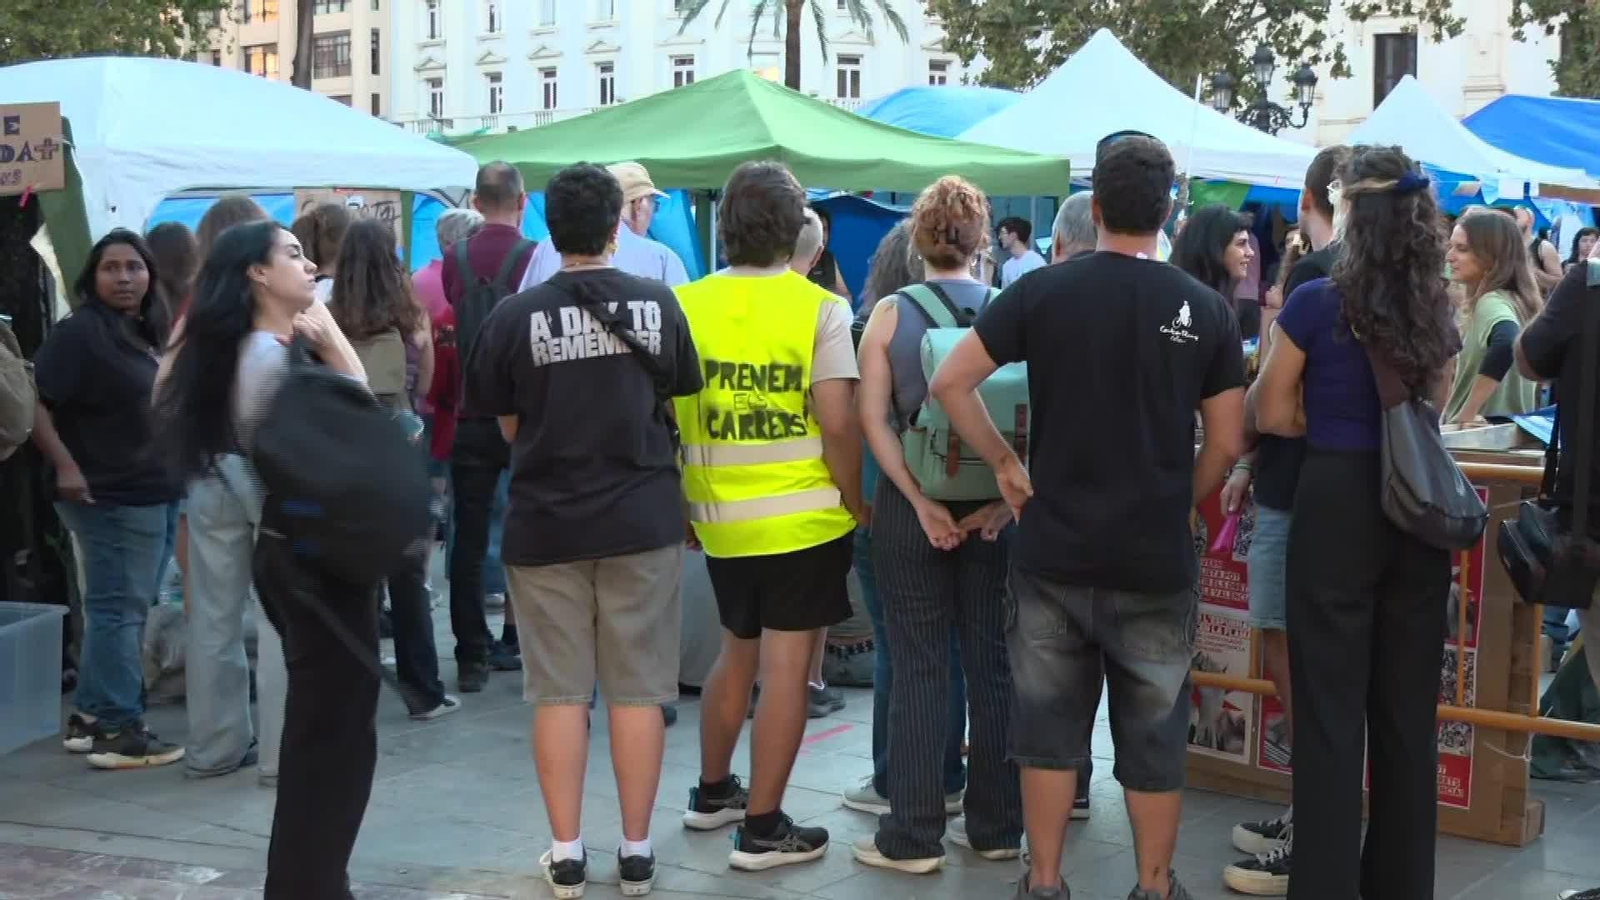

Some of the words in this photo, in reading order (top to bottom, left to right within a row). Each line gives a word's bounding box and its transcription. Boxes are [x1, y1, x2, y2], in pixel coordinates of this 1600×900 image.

[530, 310, 552, 344] A
[627, 300, 662, 331] TO
[704, 360, 803, 392] PRENEM
[706, 409, 808, 440] CARRERS
